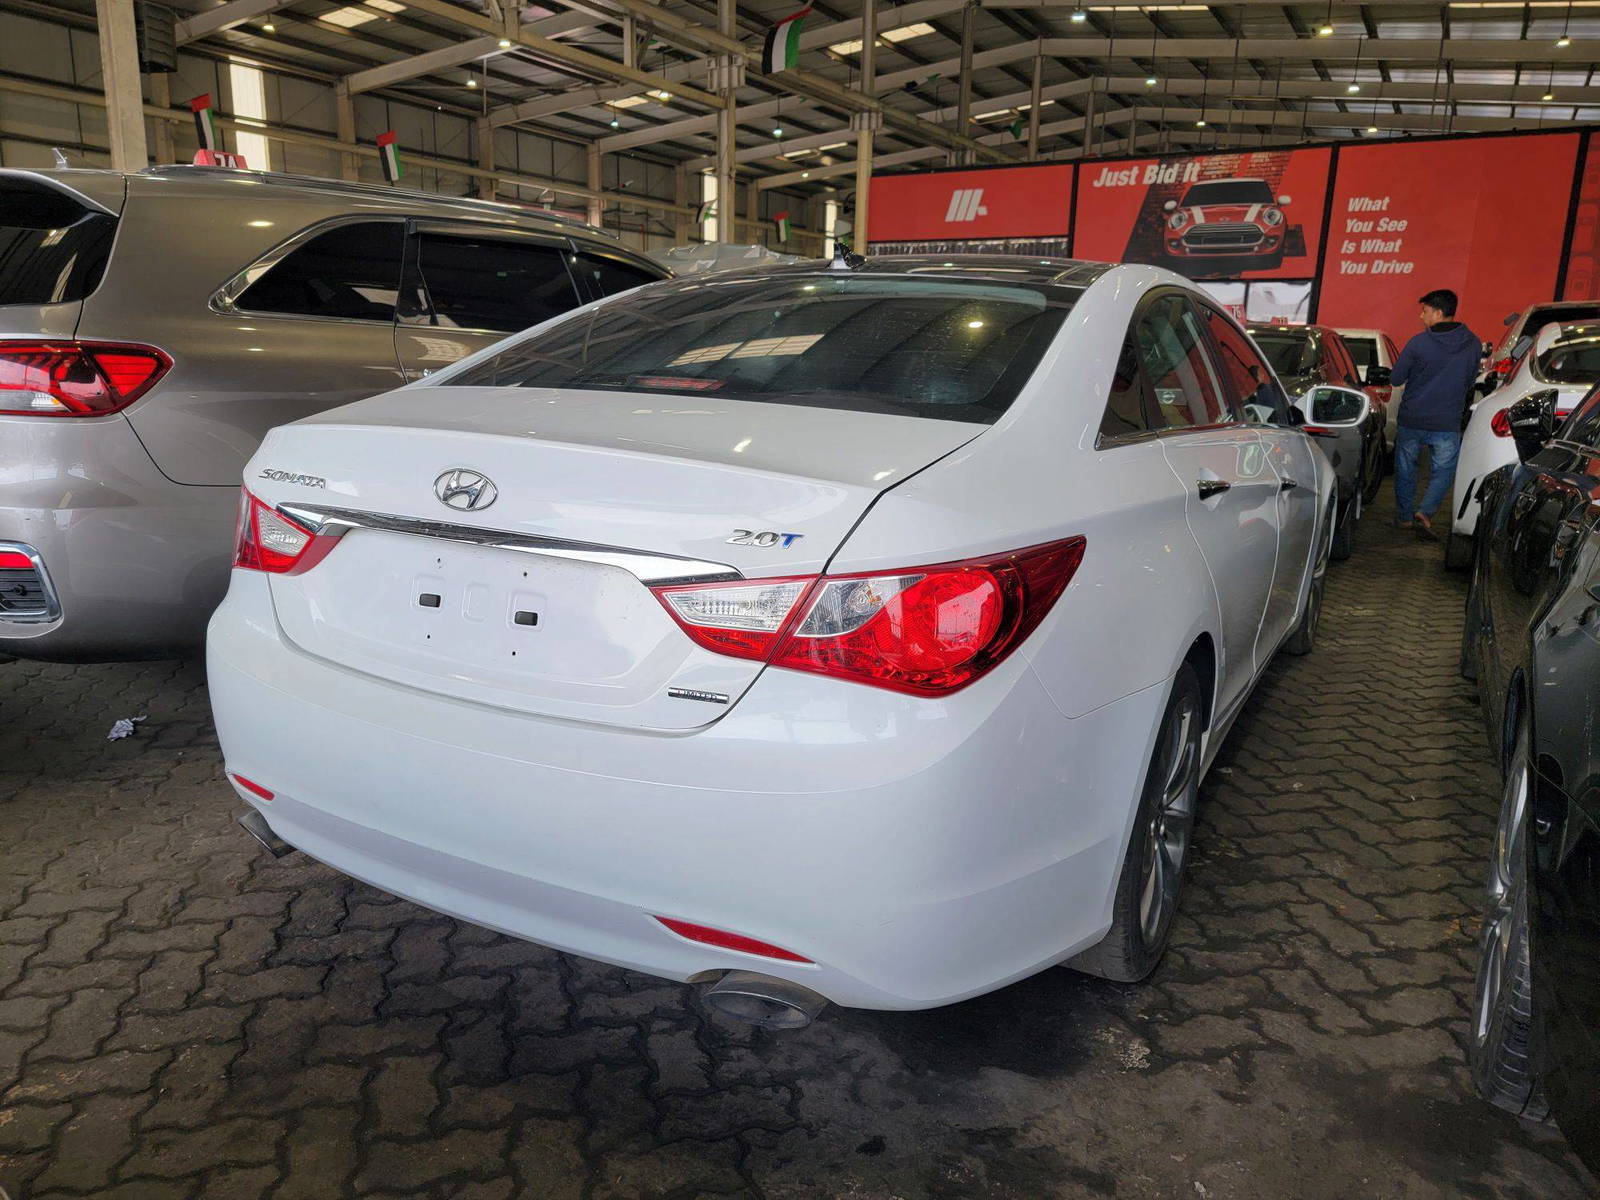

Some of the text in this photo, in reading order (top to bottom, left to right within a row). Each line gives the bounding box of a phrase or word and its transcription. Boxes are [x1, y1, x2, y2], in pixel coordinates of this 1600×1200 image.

[1093, 162, 1201, 187] Just Bid It
[1348, 196, 1390, 212] What
[1346, 217, 1408, 233] You See
[1340, 238, 1402, 254] Is What
[1340, 259, 1414, 275] You Drive
[258, 468, 327, 490] SONATA
[674, 688, 720, 703] LIMITED
